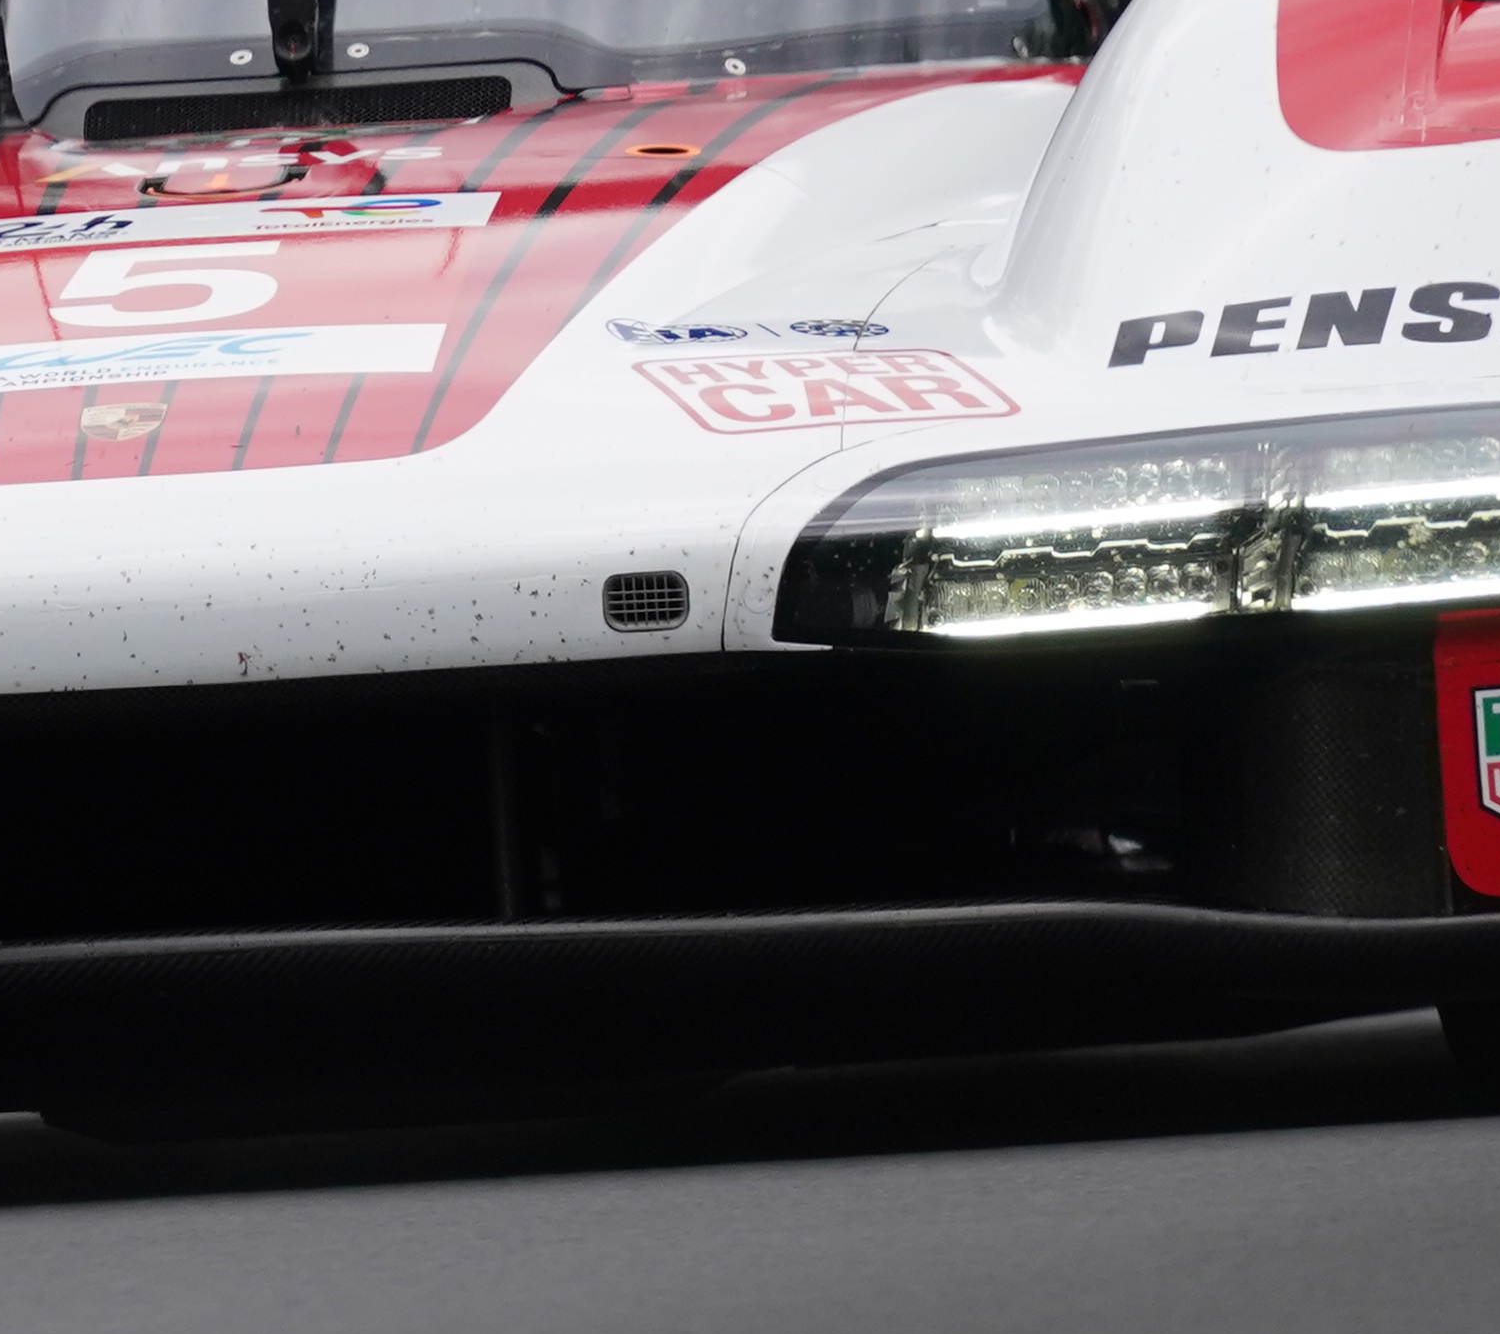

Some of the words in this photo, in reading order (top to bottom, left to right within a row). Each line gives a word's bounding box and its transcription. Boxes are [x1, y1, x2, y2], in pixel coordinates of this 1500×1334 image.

[254, 217, 434, 231] TotalEnergies
[50, 241, 280, 328] 5
[18, 366, 113, 382] WORLD
[119, 357, 281, 374] ENDURANCE
[660, 353, 945, 386] HYPER
[698, 374, 989, 423] CAR
